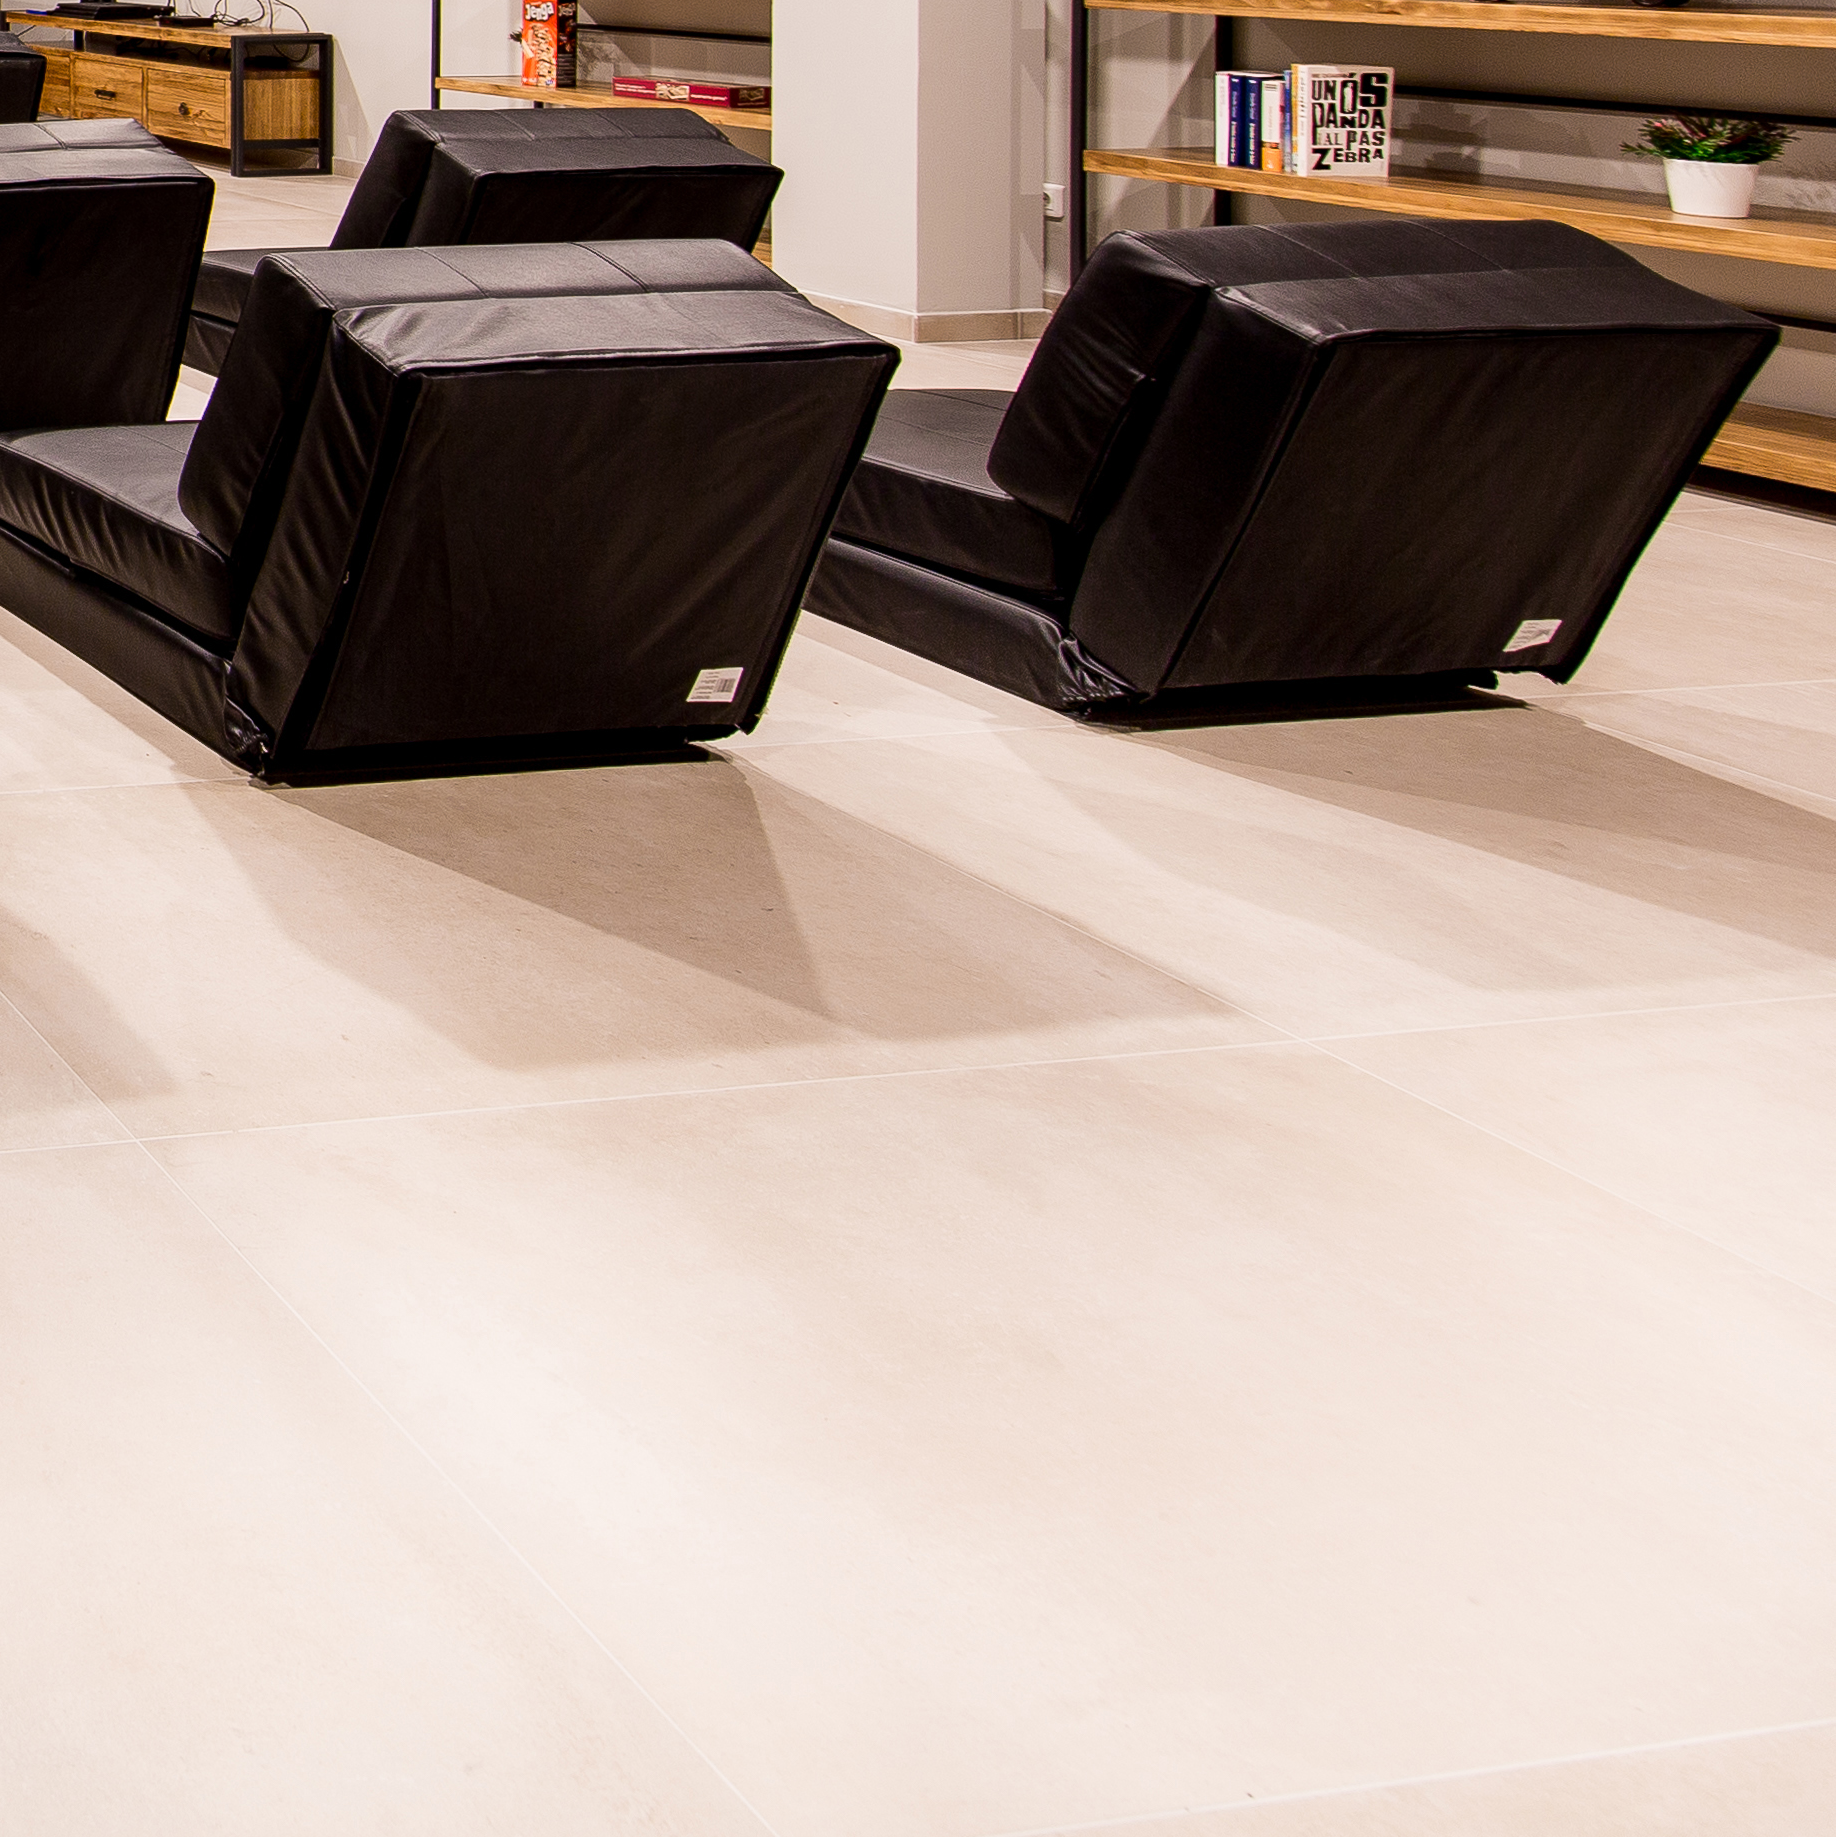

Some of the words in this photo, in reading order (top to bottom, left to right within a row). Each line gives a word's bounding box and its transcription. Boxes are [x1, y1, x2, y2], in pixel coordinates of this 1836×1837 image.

[525, 1, 555, 20] Jenga
[1311, 80, 1337, 101] UN
[1311, 102, 1386, 146] PANDA
[1346, 130, 1385, 150] PAS
[1311, 148, 1384, 170] ZEBRA
